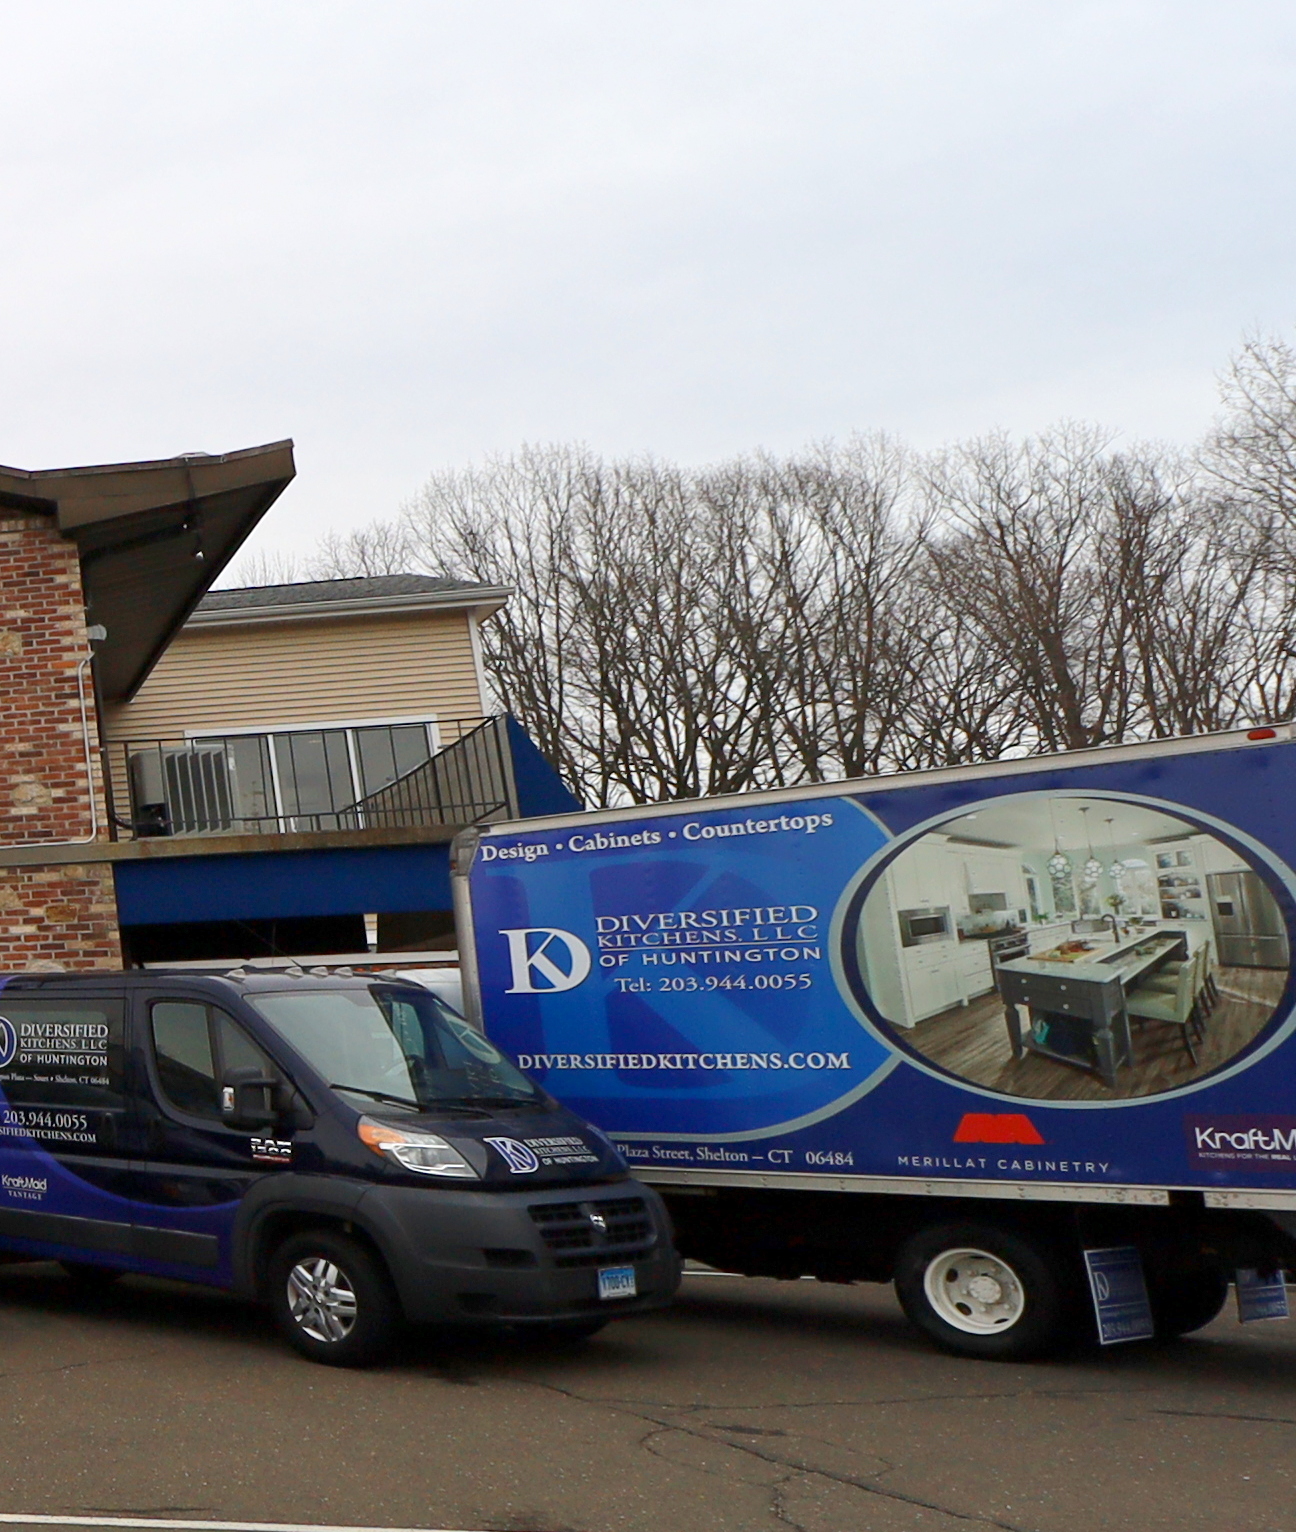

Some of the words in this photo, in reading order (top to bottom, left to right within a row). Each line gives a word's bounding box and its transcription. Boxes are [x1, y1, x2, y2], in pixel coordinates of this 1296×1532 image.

[480, 843, 549, 863] Design
[568, 830, 661, 853] Cabinets
[682, 811, 834, 842] Countertops
[595, 905, 819, 934] DIVERSIFIED
[598, 954, 630, 968] OF
[642, 947, 821, 967] HUNTINGTON
[614, 977, 652, 993] Tel:
[659, 973, 812, 992] 203.944.0055
[20, 1023, 108, 1038] DIVERSIFIED
[19, 1053, 33, 1064] OF
[37, 1054, 108, 1066] HUNTINGTON
[518, 1051, 852, 1071] DIVERSIFIEDKITCHENS.COM
[3, 1110, 88, 1131] 203.944.0055
[522, 1136, 584, 1148] DIVERSIFIED
[553, 1155, 600, 1164] HUNTINGTON
[616, 1144, 649, 1158] Plaza
[652, 1146, 694, 1161] Street,
[696, 1147, 748, 1162] Shelton
[767, 1150, 793, 1164] CT
[805, 1151, 854, 1166] 06484
[897, 1156, 987, 1170] MERILLAT
[997, 1159, 1109, 1173] CABINETRY
[1, 1174, 47, 1190] KraftMaid
